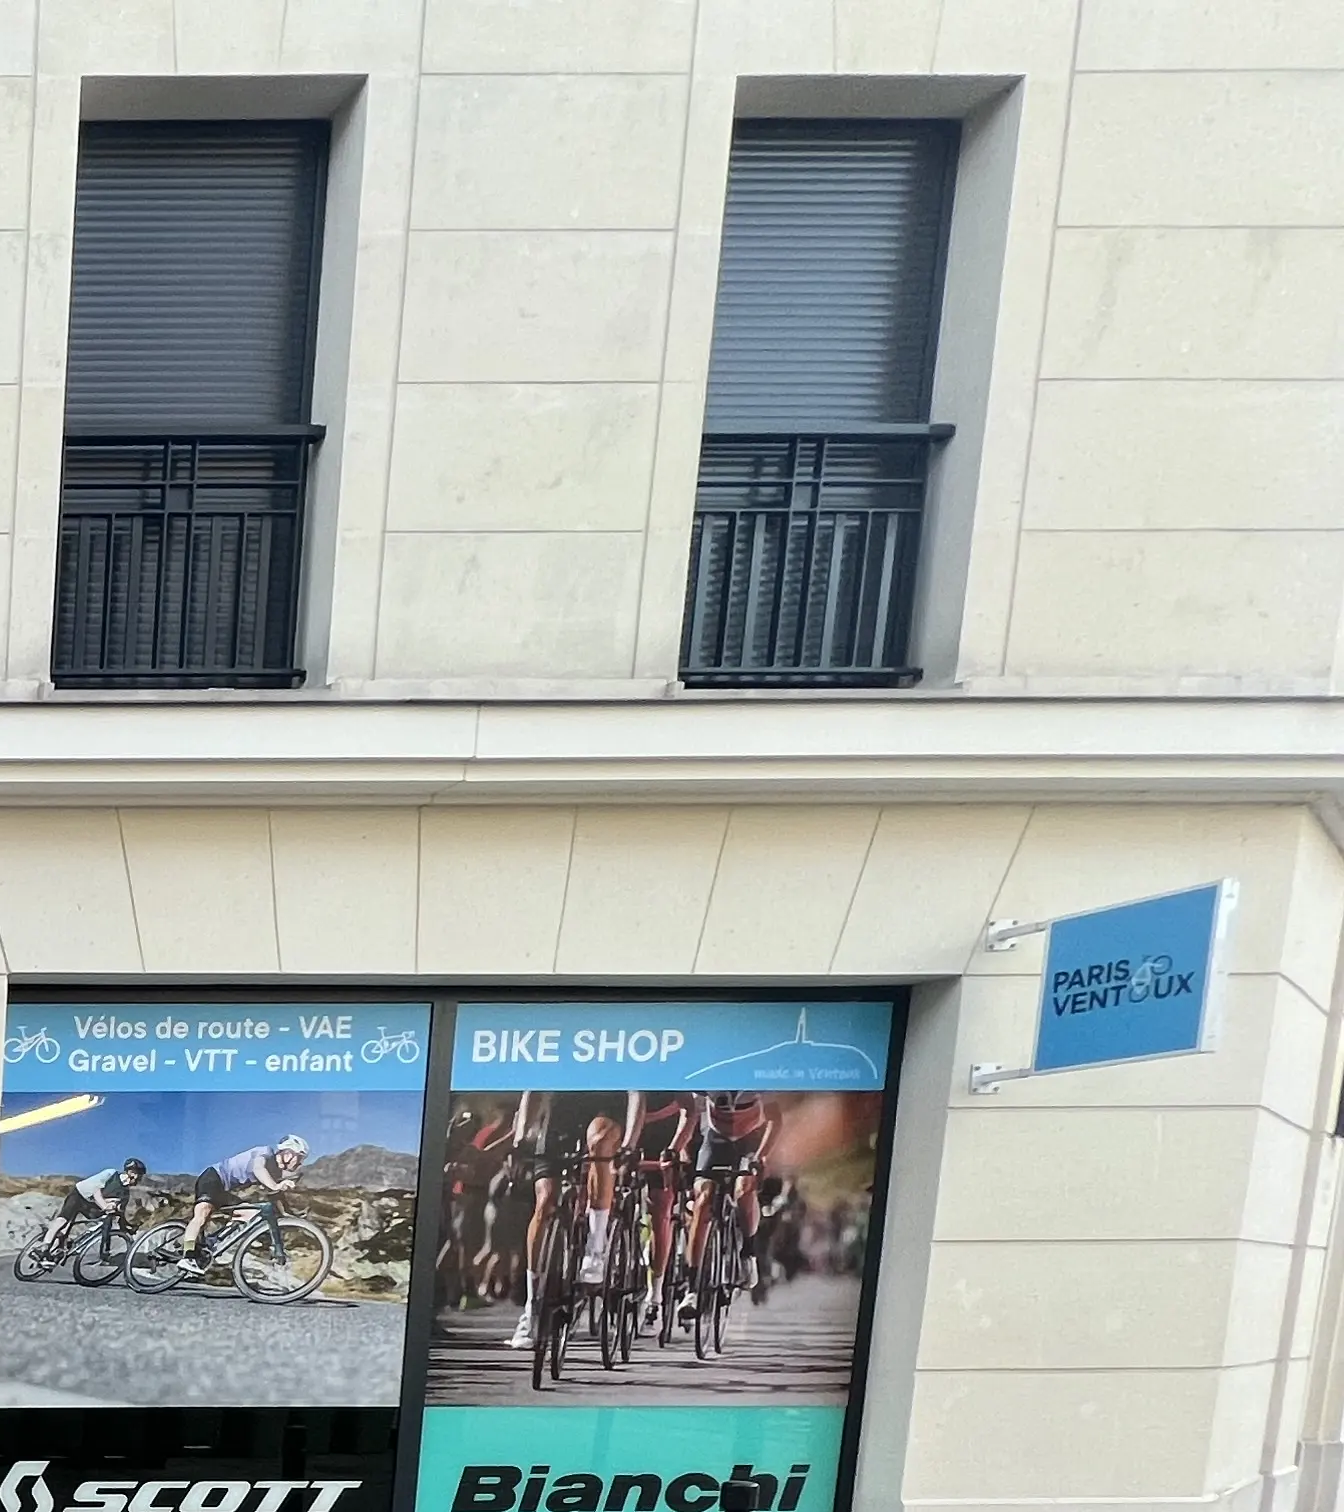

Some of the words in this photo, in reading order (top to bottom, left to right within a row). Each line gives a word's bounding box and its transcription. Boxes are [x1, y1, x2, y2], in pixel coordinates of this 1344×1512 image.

[1053, 959, 1130, 993] PARIS
[73, 1015, 147, 1040] Vélos
[155, 1015, 189, 1040] de
[197, 1017, 270, 1040] route
[299, 1015, 353, 1040] VAE
[68, 1048, 156, 1073] Gravel
[184, 1048, 239, 1073] VTT
[264, 1048, 354, 1073] enfant
[471, 1029, 562, 1063] BIKE
[572, 1029, 685, 1063] SHOP
